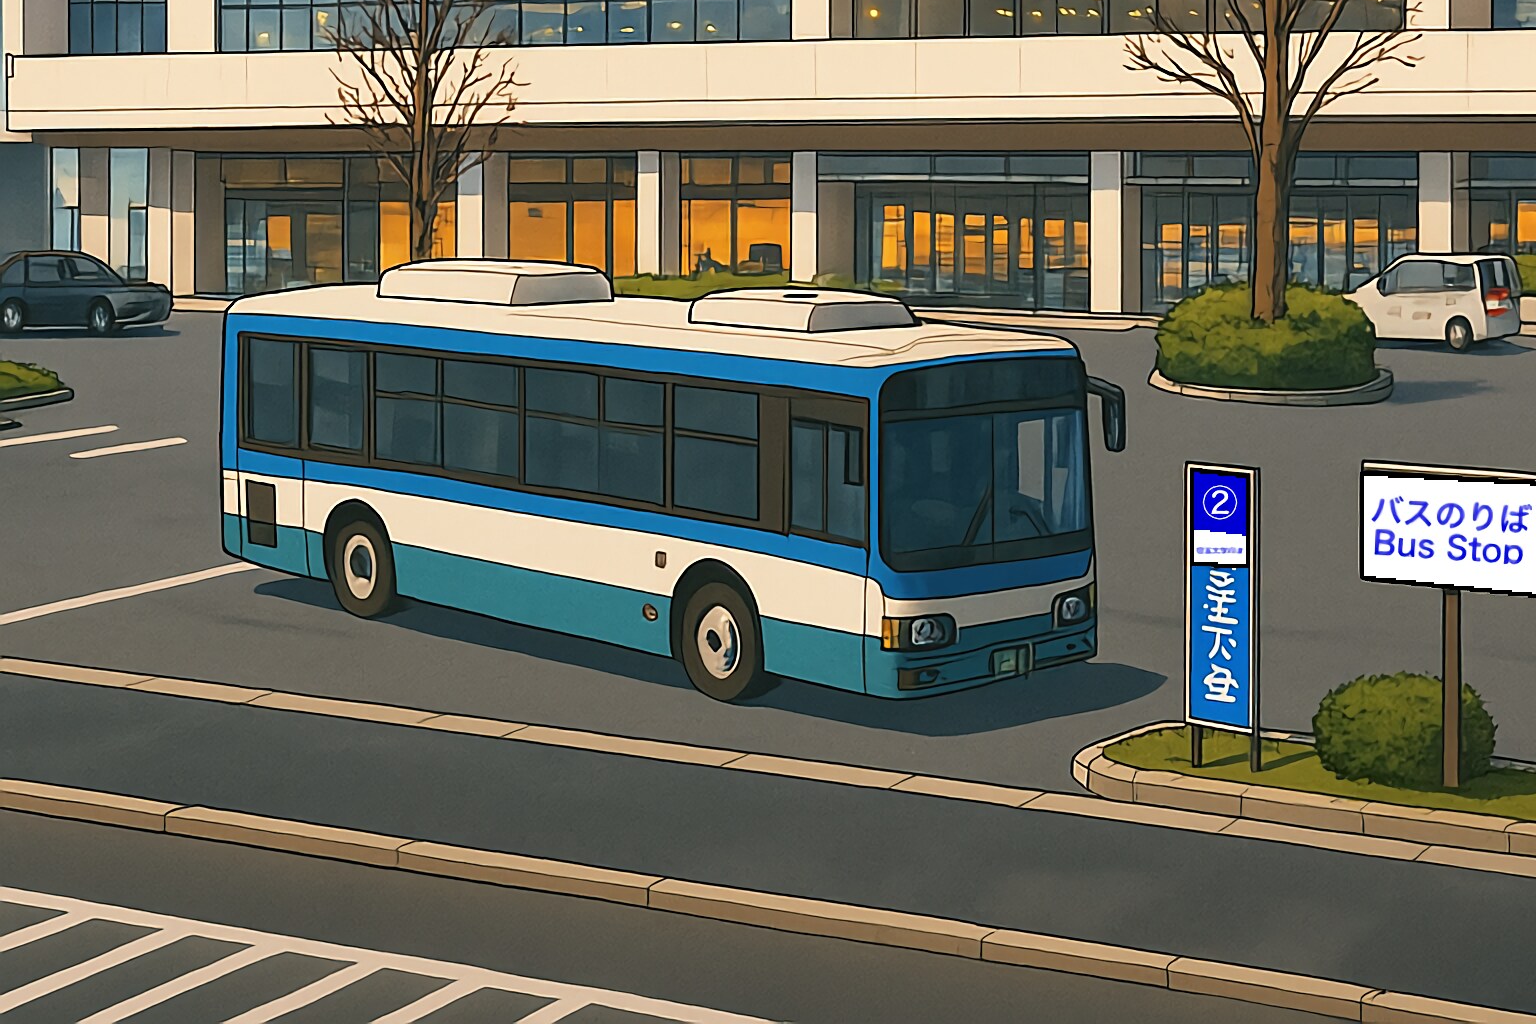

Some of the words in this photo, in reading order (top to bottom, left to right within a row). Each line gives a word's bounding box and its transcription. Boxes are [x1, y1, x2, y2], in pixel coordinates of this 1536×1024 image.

[1372, 497, 1532, 533] バスのりば
[1374, 529, 1434, 559] Bus
[1448, 533, 1523, 564] Stop
